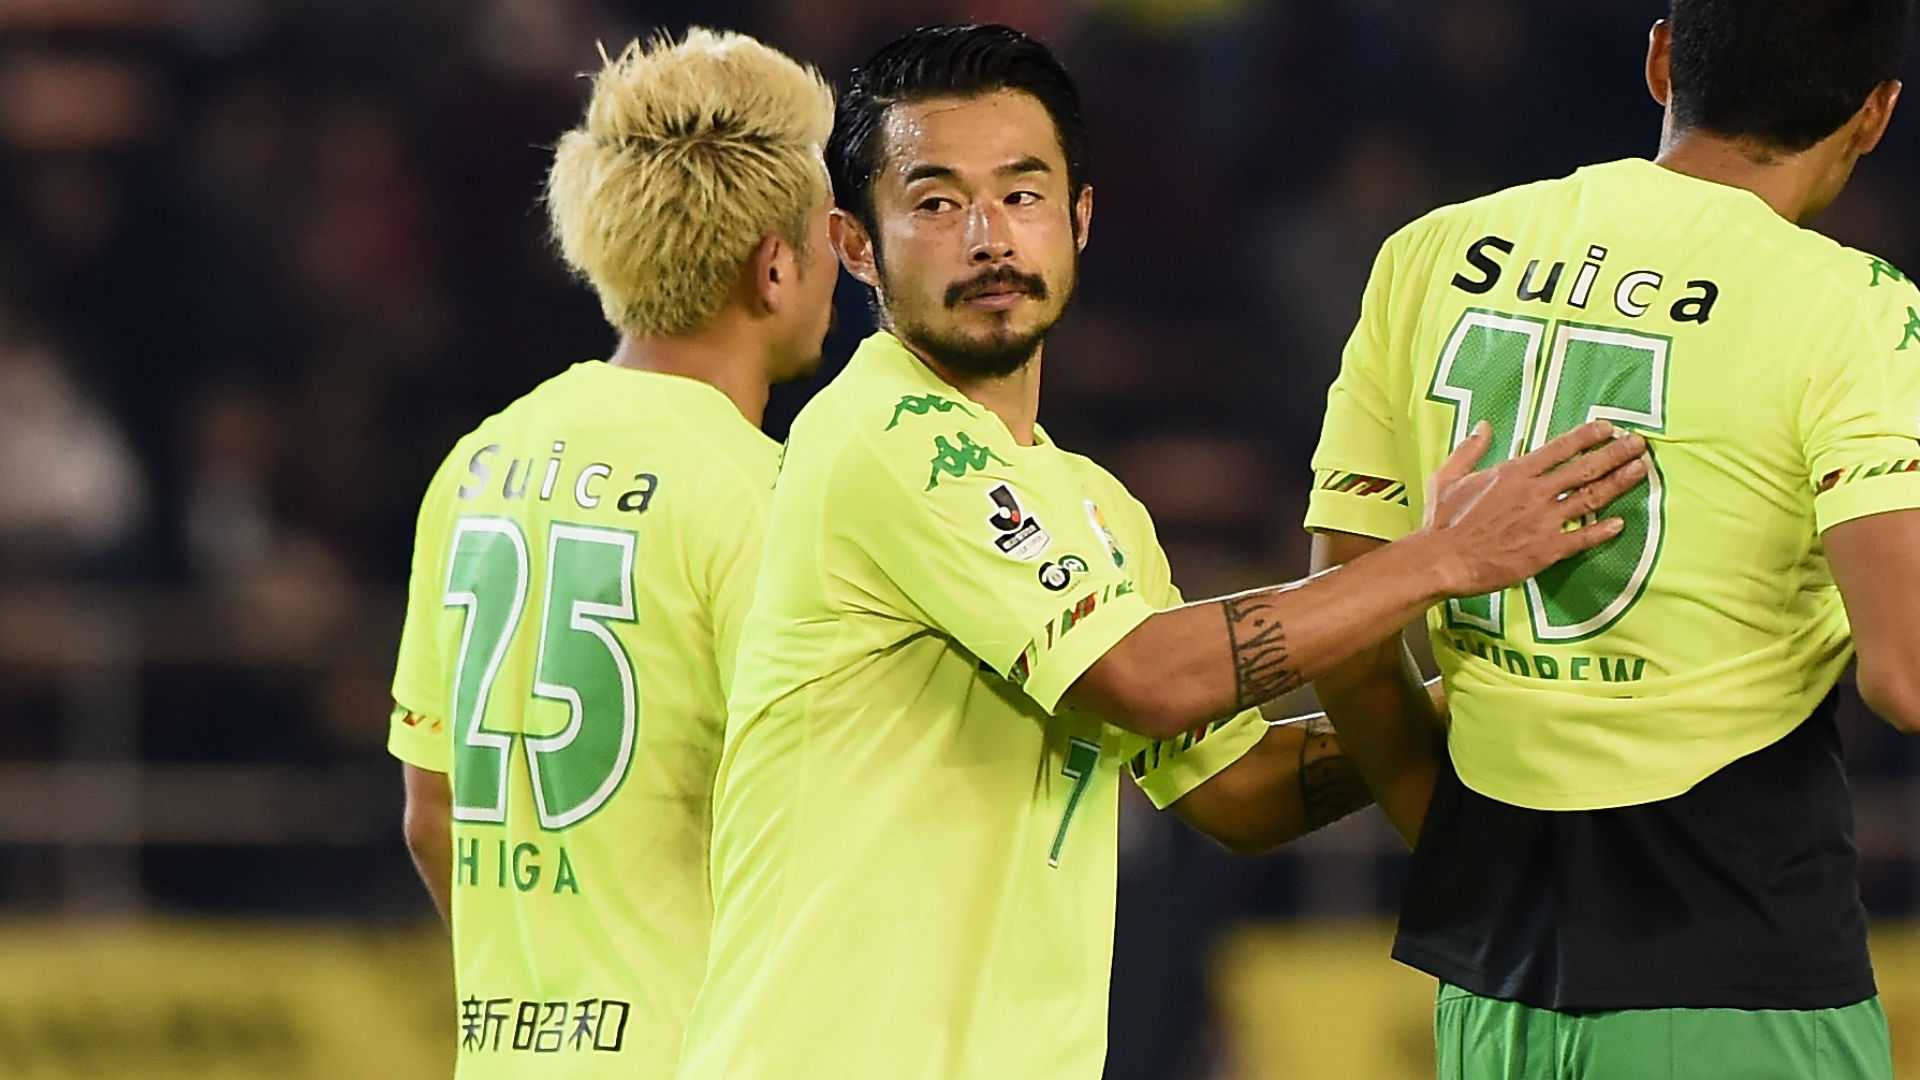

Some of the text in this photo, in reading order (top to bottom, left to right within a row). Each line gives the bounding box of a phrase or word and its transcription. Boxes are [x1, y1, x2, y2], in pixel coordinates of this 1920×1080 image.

[1451, 236, 1719, 324] Suica
[458, 441, 658, 514] Suica
[1426, 306, 1673, 644] 15
[444, 516, 638, 832] 25
[1454, 639, 1646, 682] NDREW
[1048, 736, 1101, 869] 7
[457, 837, 579, 894] HIGA
[462, 994, 630, 1053] 新昭和
